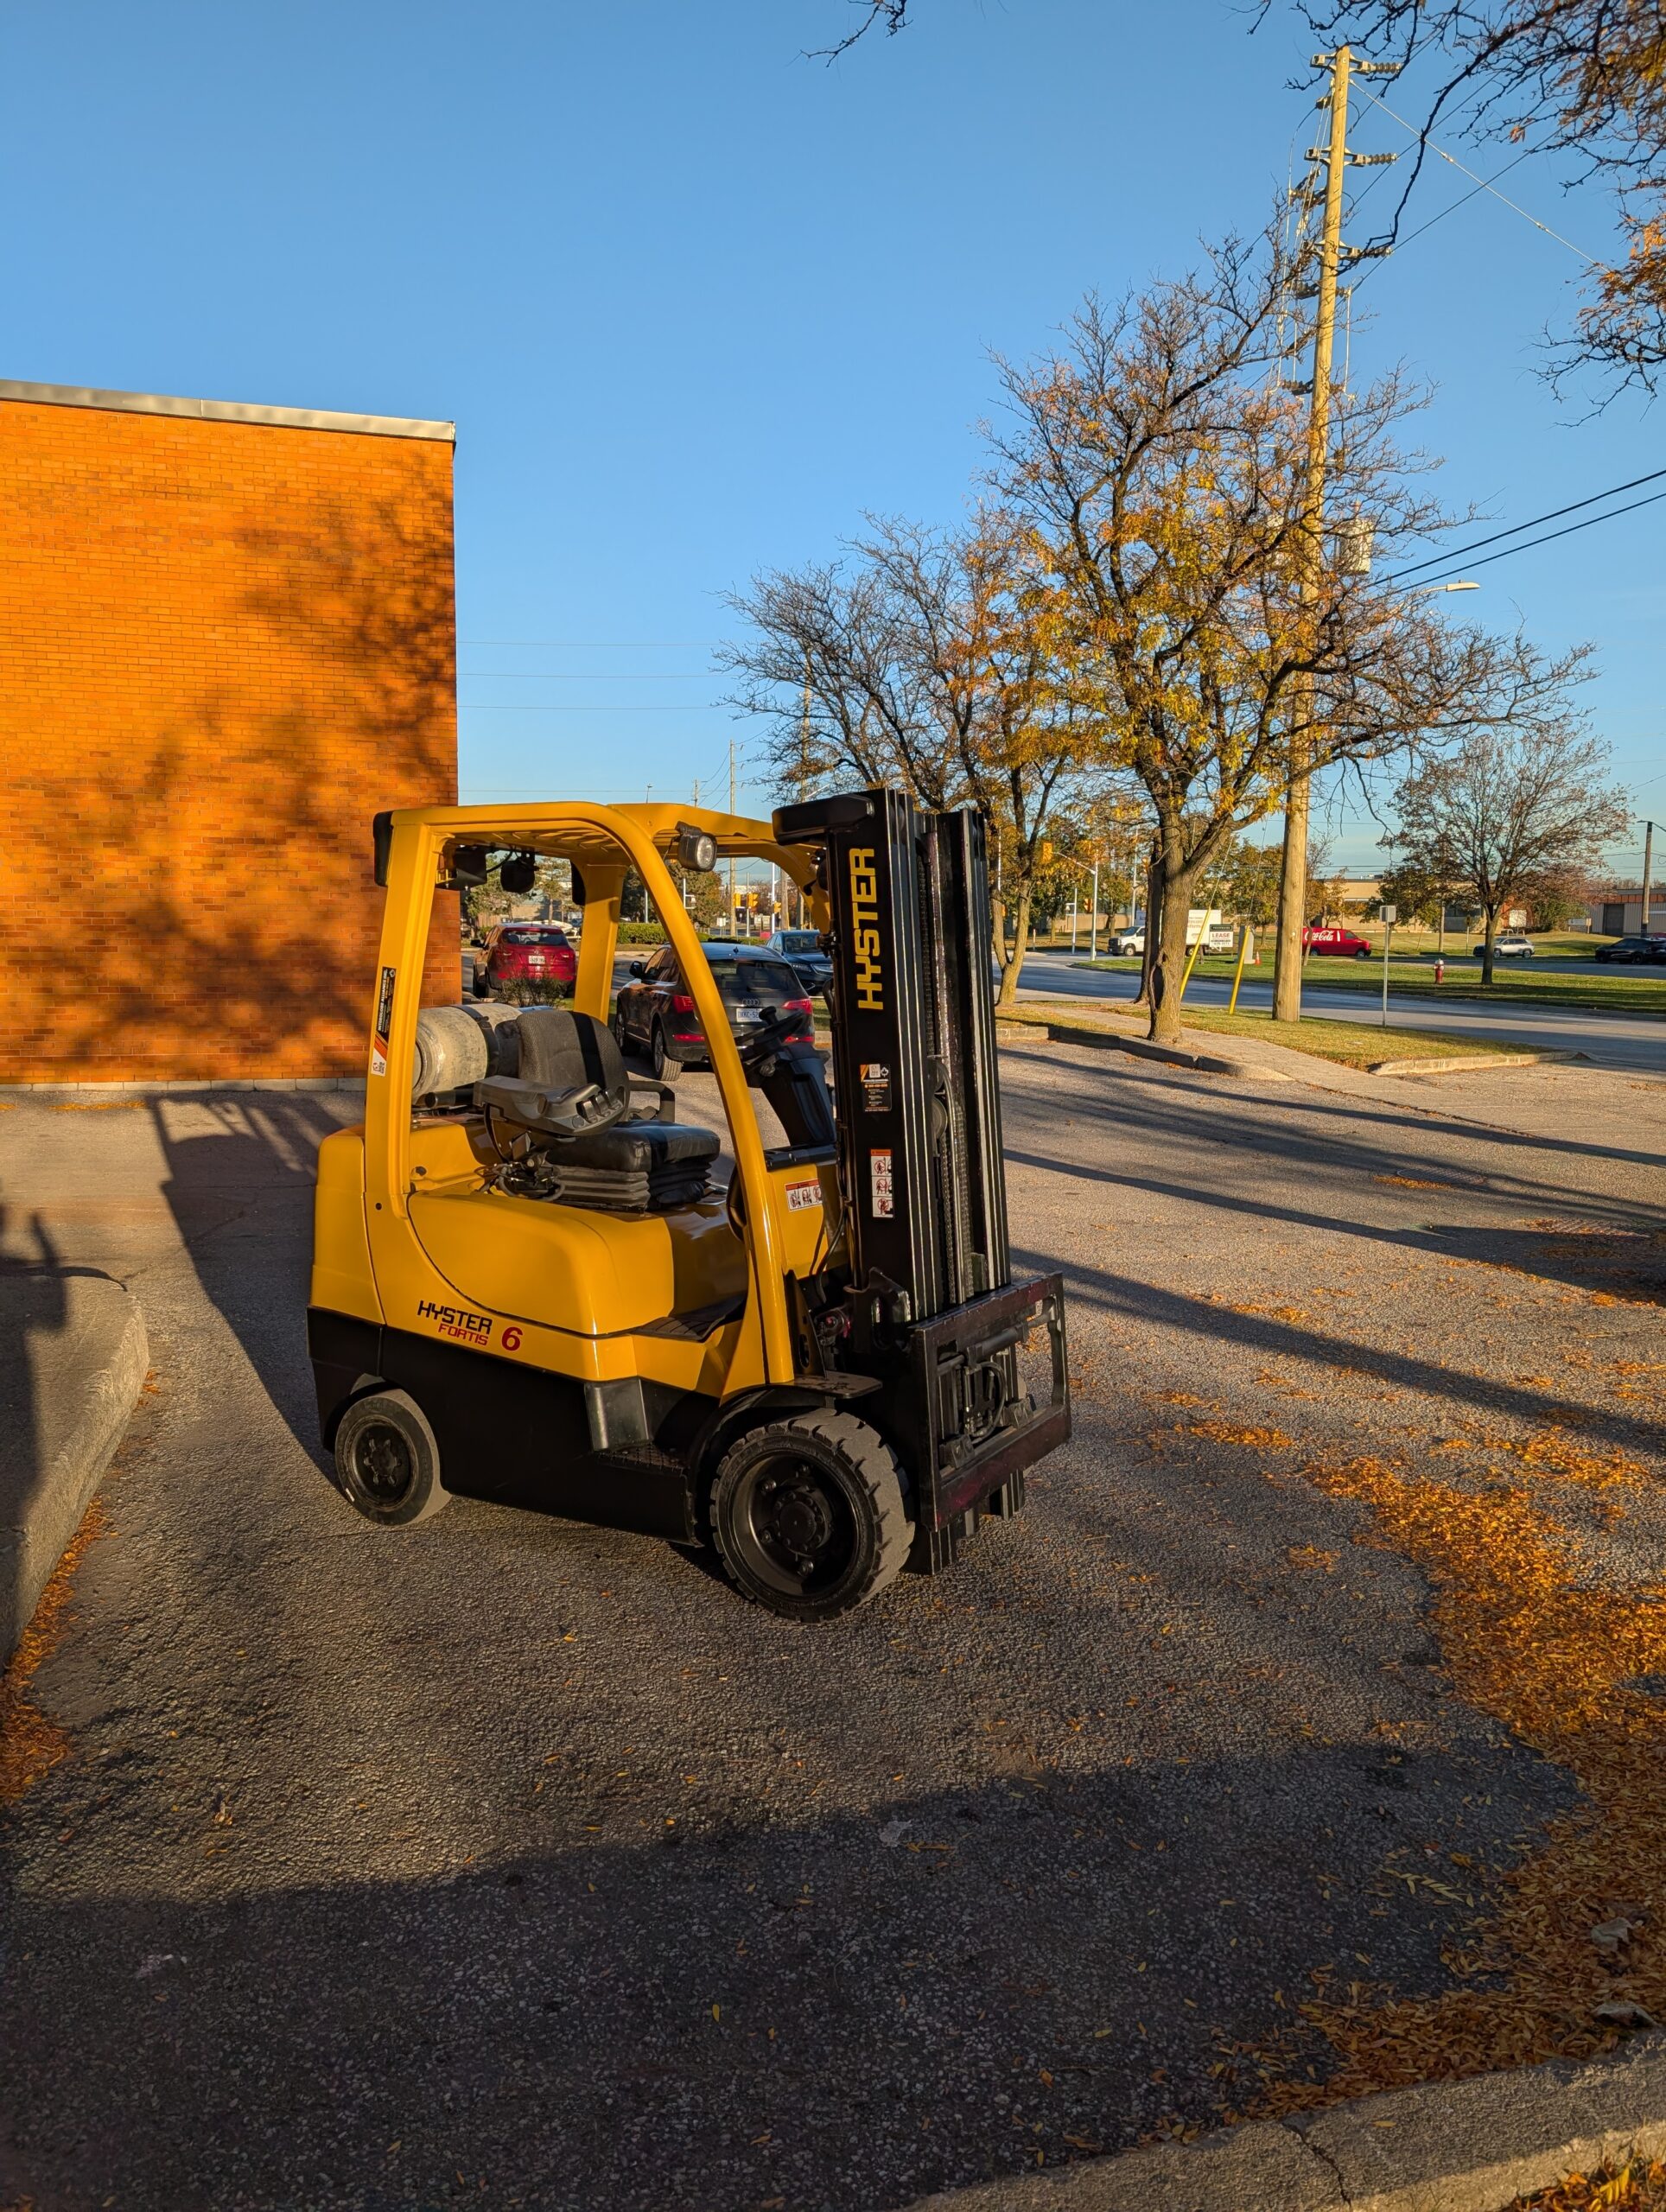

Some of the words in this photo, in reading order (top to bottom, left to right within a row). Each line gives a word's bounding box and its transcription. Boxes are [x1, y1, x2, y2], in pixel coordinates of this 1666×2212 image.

[849, 848, 884, 1010] HYSTER
[1305, 930, 1334, 940] Cca-Cola
[417, 1300, 493, 1335] HYSTER
[438, 1323, 488, 1346] FORTIS
[501, 1326, 524, 1351] 6
